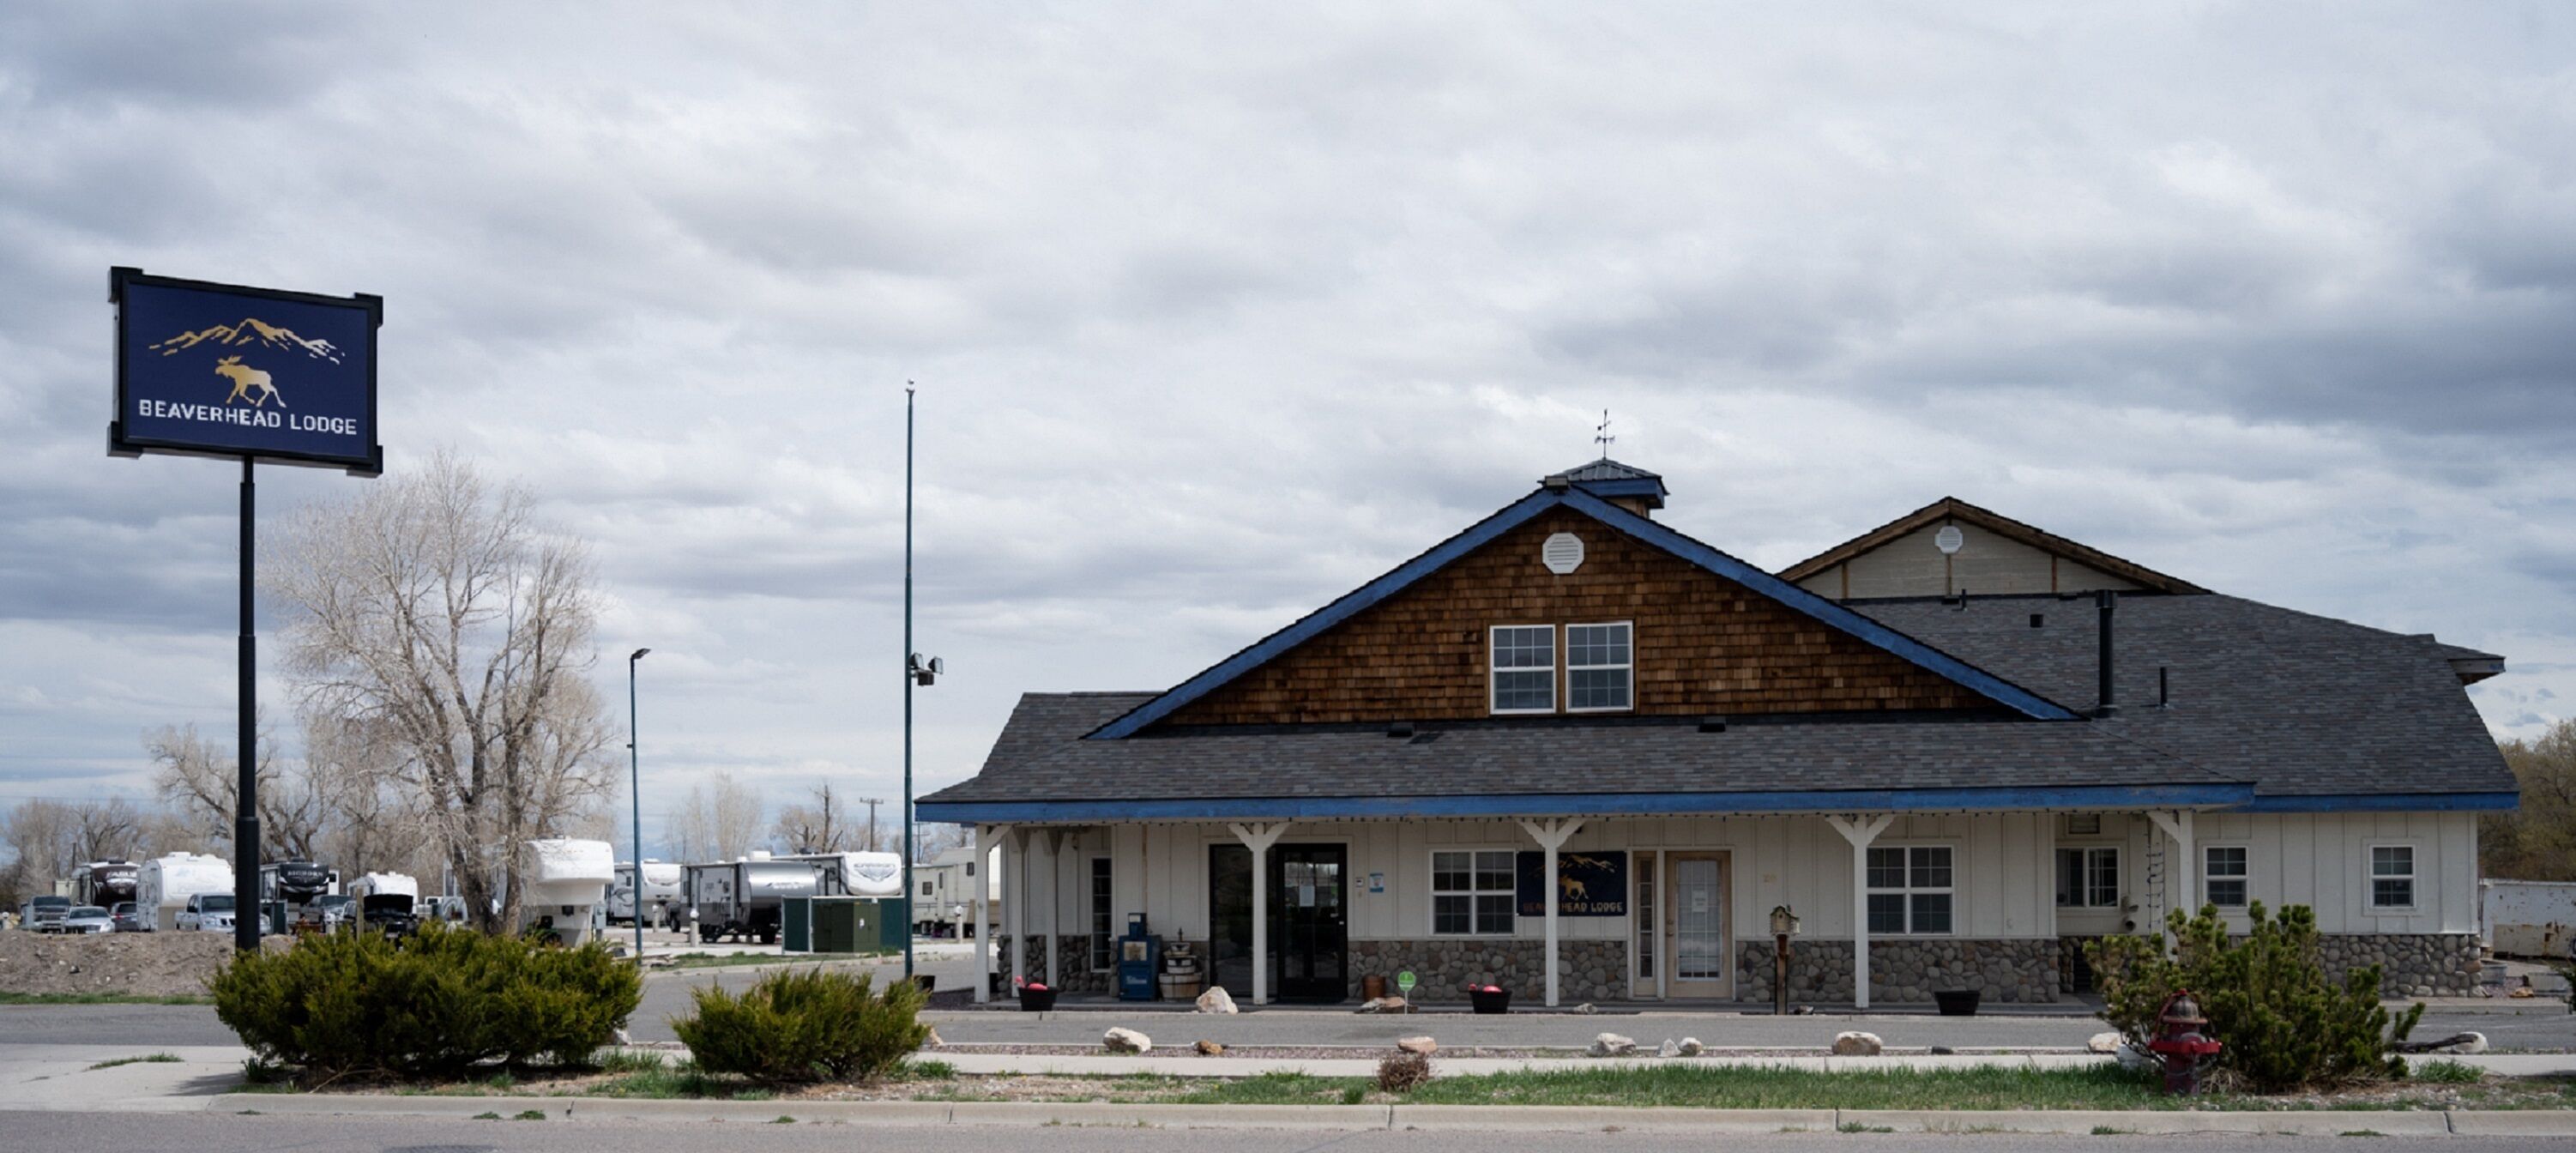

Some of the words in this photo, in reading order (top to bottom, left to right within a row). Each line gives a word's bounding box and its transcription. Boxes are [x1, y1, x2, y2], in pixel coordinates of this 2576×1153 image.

[139, 399, 281, 427] BEAVERHEAD
[290, 414, 357, 435] LODGE
[1590, 902, 1623, 912] LODGE
